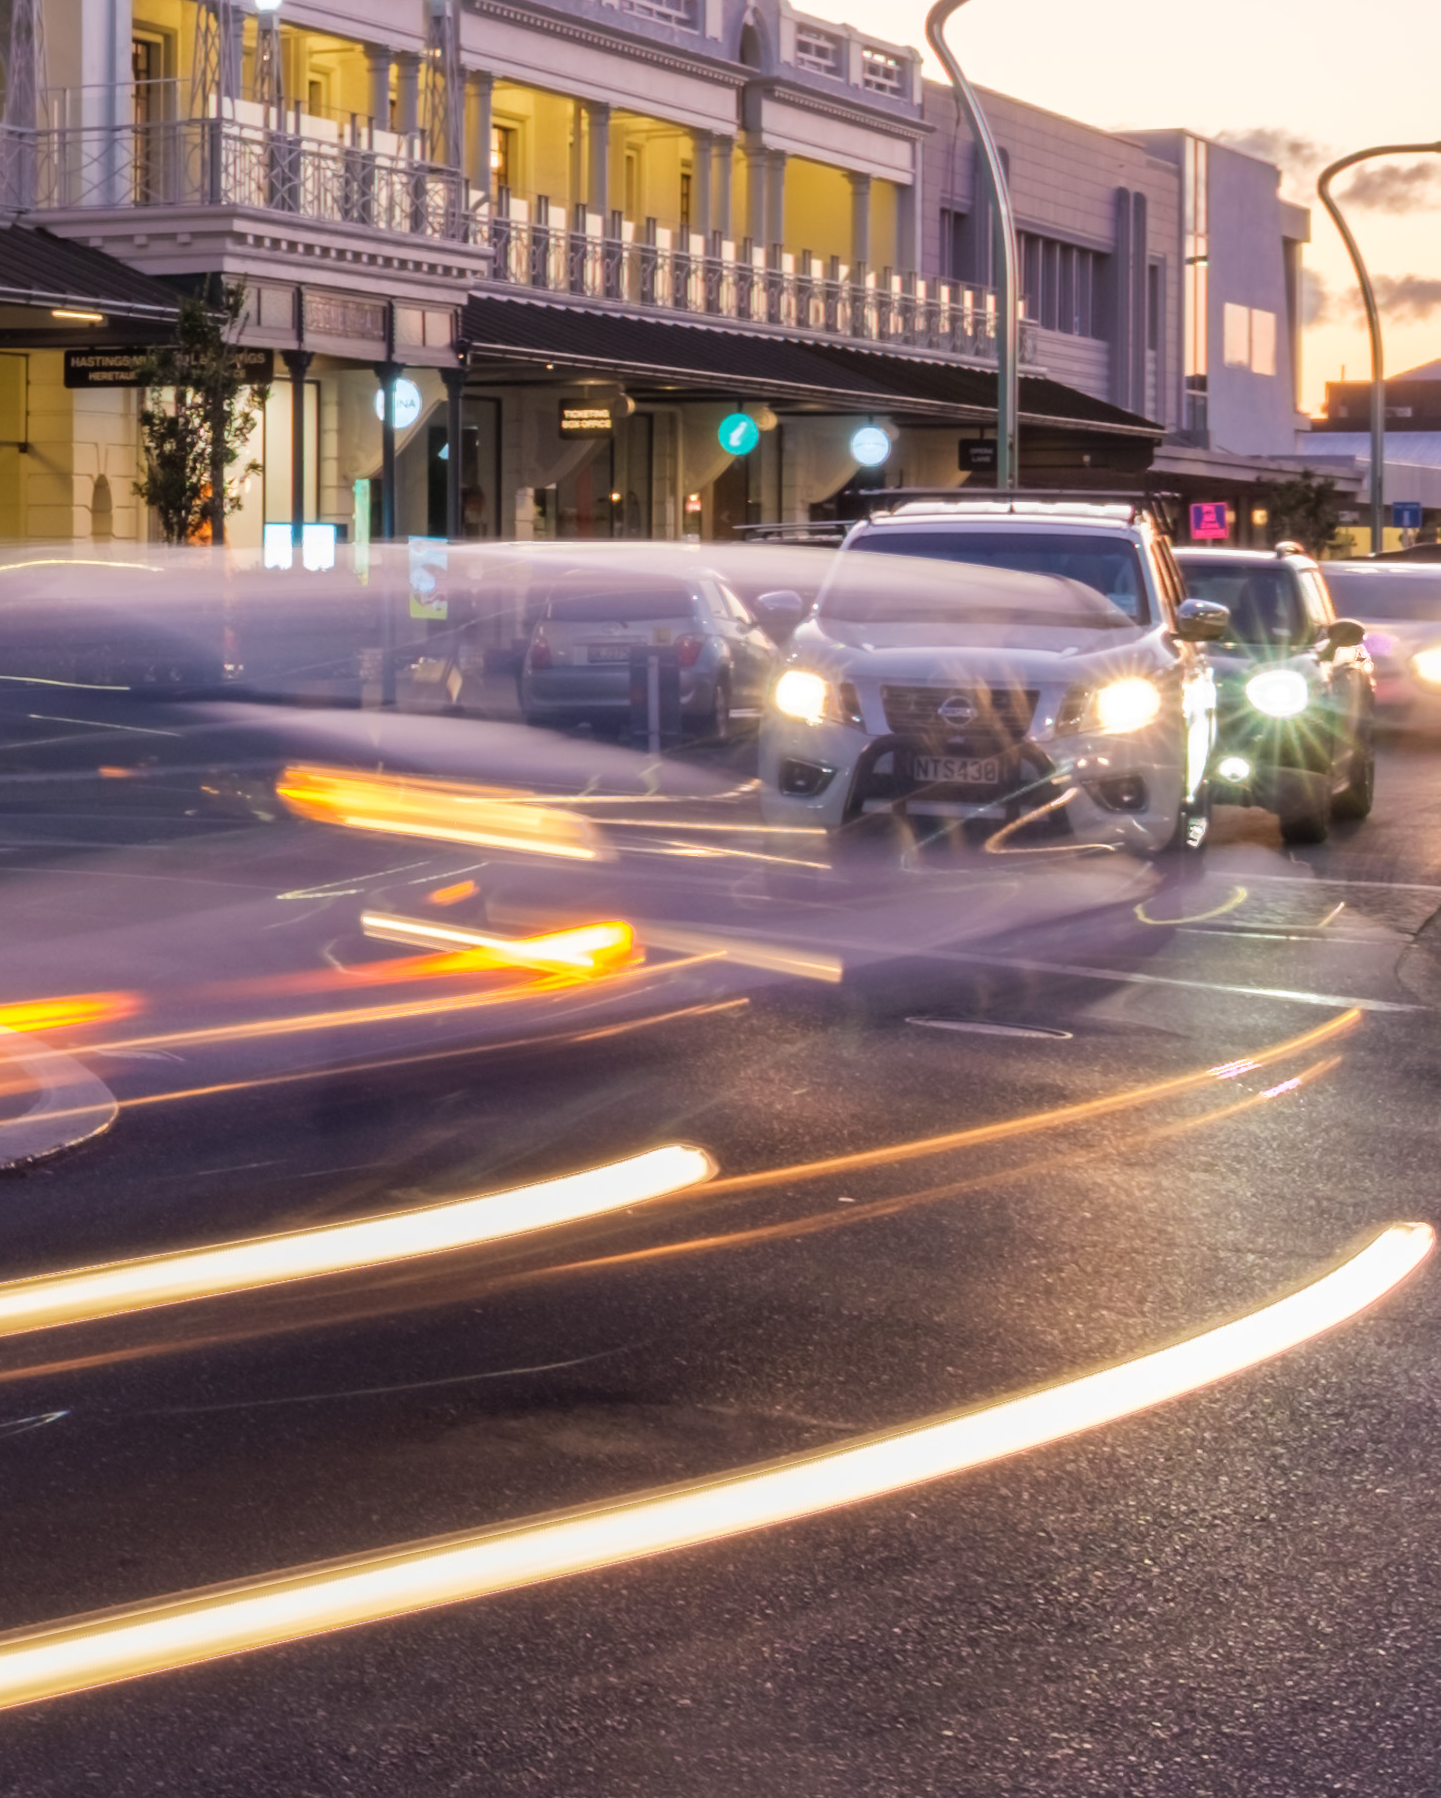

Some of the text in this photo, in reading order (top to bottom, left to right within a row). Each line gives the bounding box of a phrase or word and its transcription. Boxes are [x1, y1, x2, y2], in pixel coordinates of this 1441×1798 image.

[71, 355, 129, 367] HASTINGS
[563, 409, 610, 419] TICKETING
[561, 419, 612, 429] BOX OFFICE
